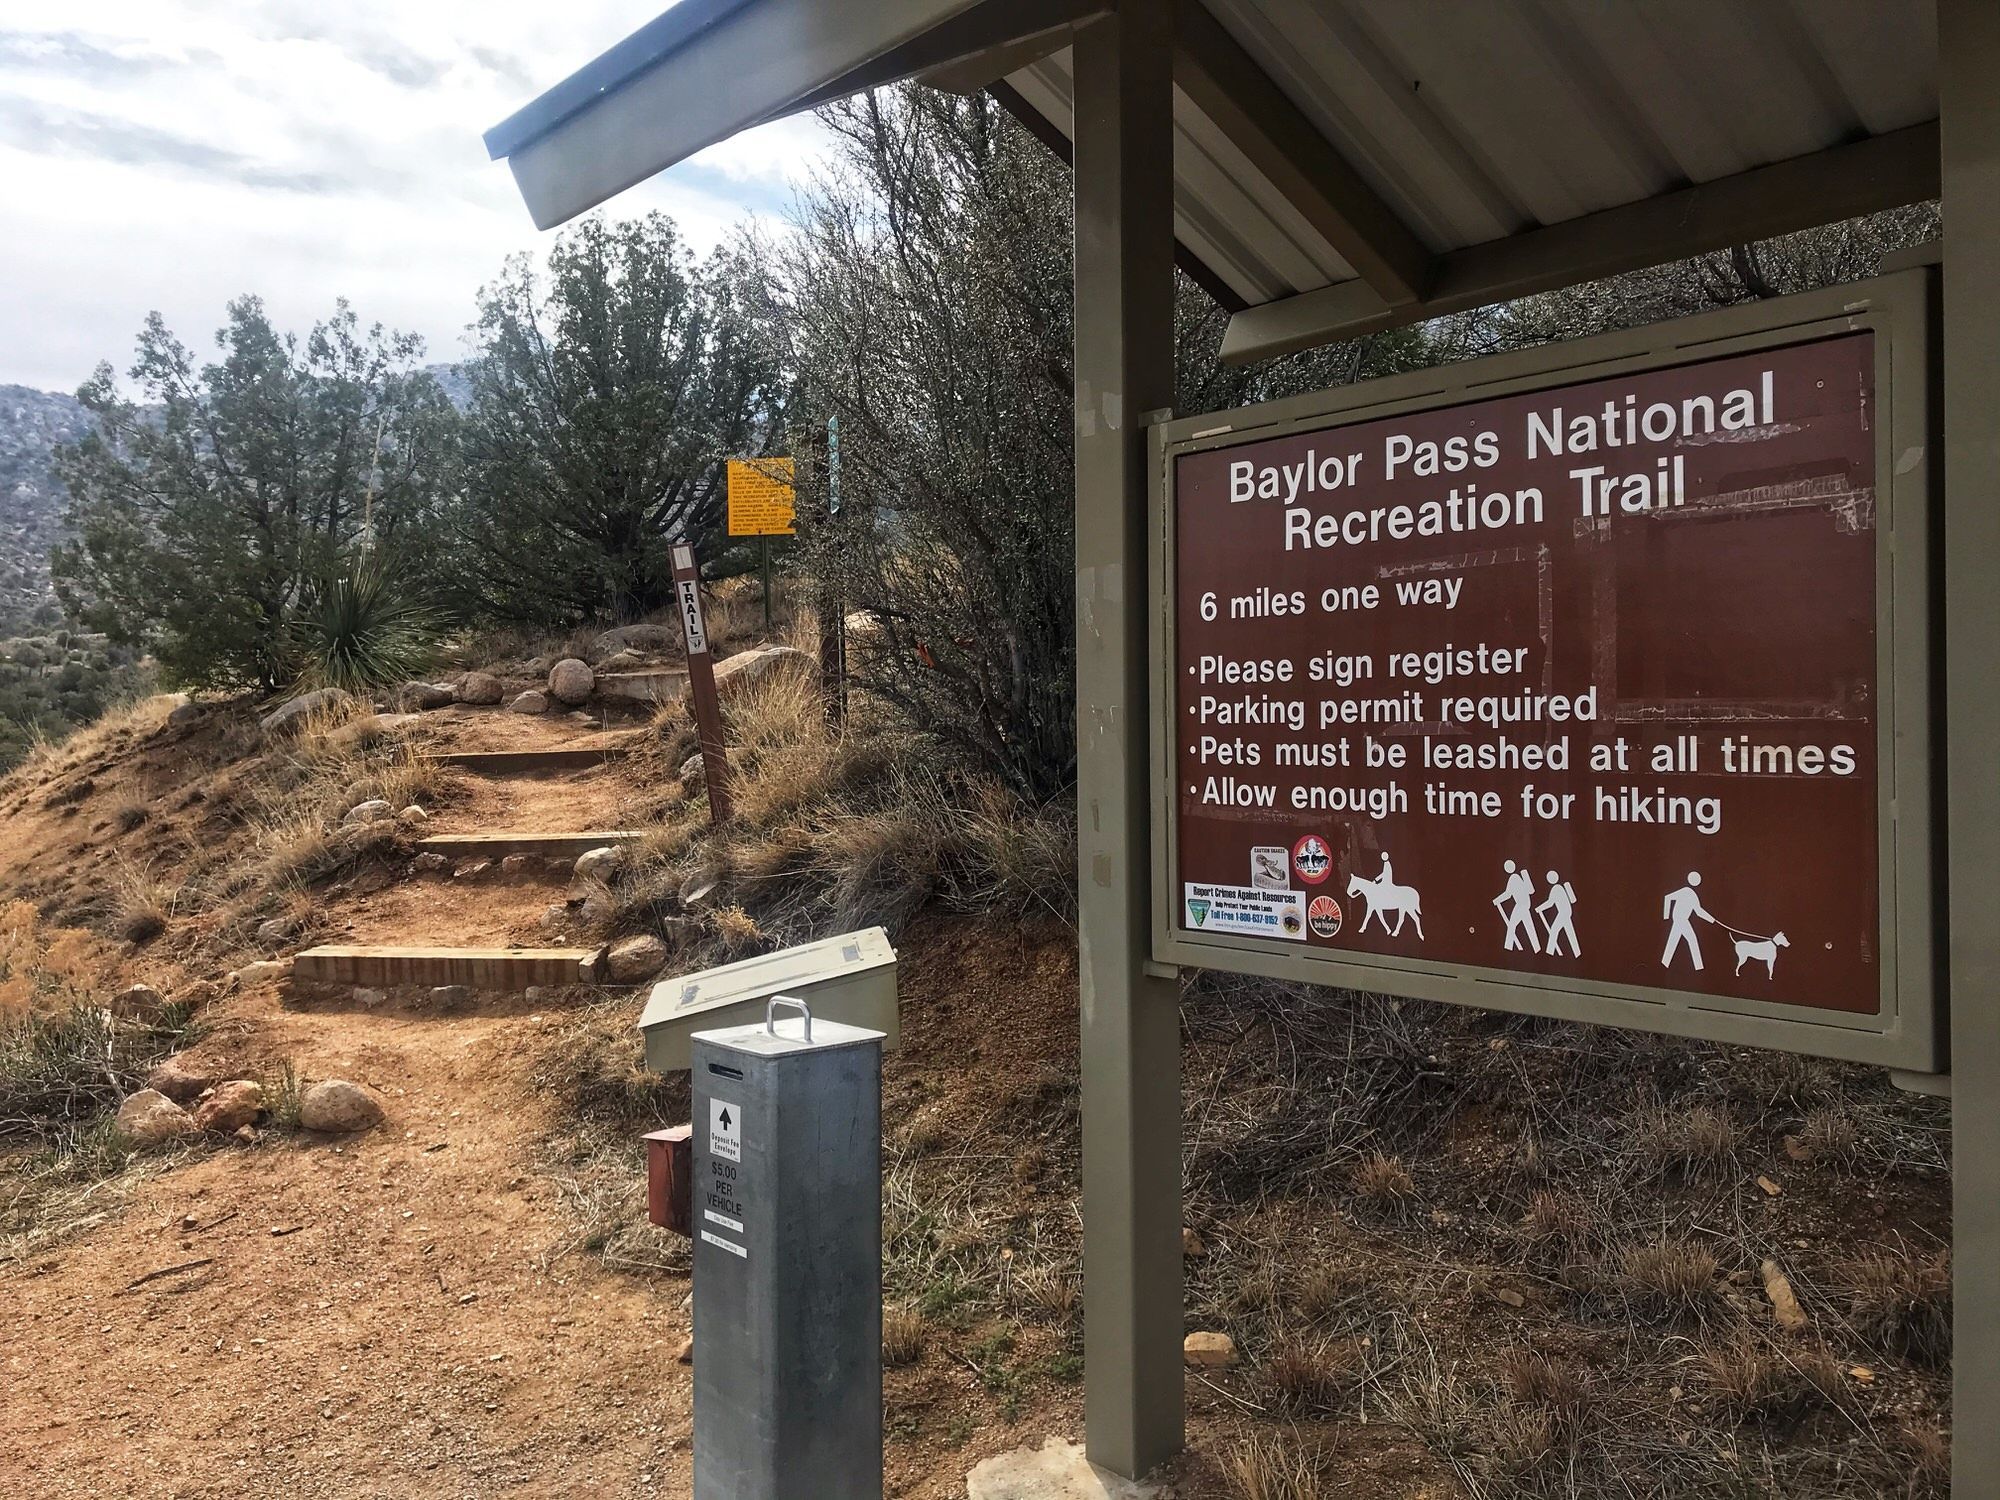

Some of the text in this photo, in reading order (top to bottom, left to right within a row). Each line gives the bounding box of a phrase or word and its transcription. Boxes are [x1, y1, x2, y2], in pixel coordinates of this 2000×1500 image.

[1231, 371, 1773, 504] Baylor Pass National
[1285, 455, 1684, 550] Recreation Trail
[682, 583, 699, 635] TRAIL
[1201, 578, 1462, 621] 6 miles one way
[1201, 644, 1527, 686] Please sign register
[1201, 686, 1596, 730] Parking permit required
[1202, 736, 1855, 774] Pets must be leashed at all times
[1203, 777, 1720, 834] Allow enough time for hiking
[1193, 886, 1297, 904] Report Crimes Against Resources
[1211, 910, 1220, 919] Toll
[1221, 911, 1234, 920] Free
[711, 1132, 739, 1149] Deposit Fee
[714, 1141, 736, 1156] Envelope
[711, 1161, 737, 1181] $5.00
[715, 1180, 733, 1197] PER
[707, 1191, 742, 1217] VEHICLE
